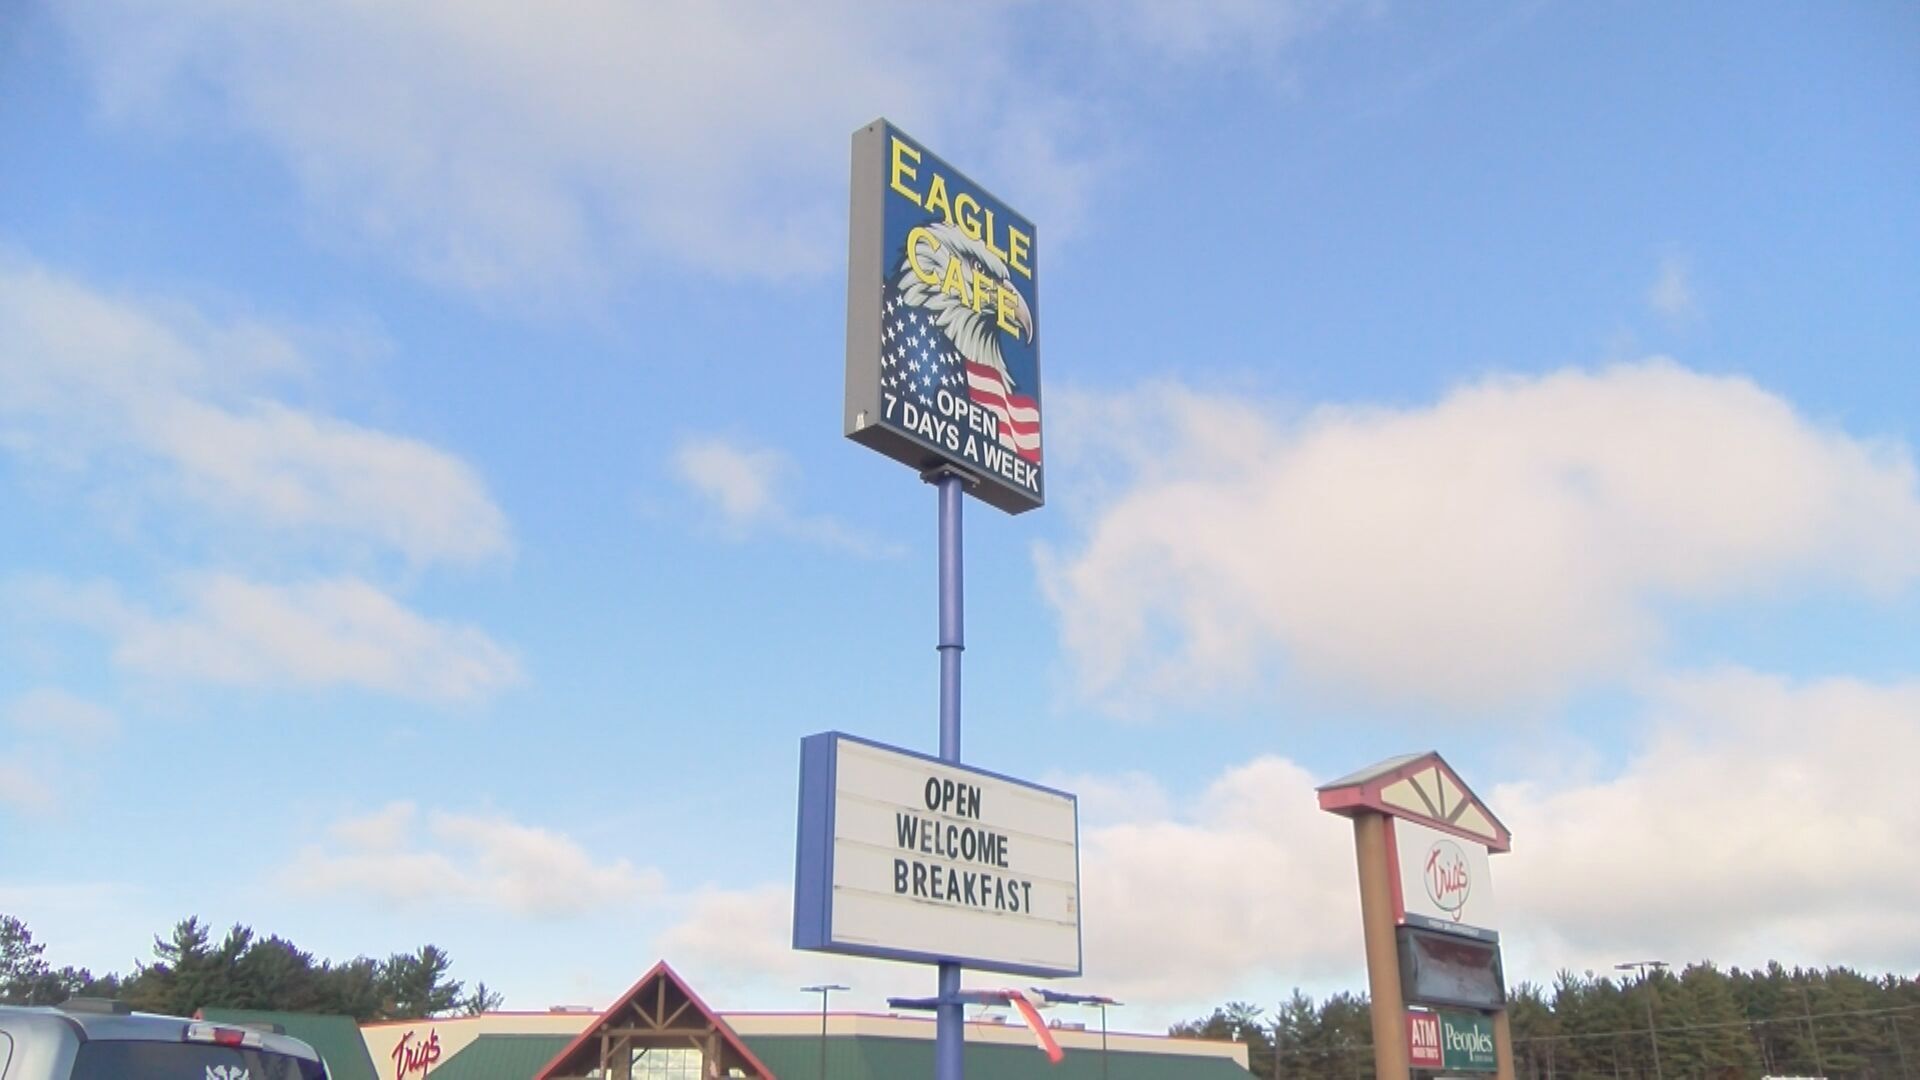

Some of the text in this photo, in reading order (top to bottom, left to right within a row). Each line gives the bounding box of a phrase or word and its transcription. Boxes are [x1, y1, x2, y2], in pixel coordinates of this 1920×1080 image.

[890, 135, 1032, 280] EAGLE
[906, 226, 1020, 340] CAFE
[884, 392, 1039, 493] 7 DAYS A WEEK
[936, 389, 997, 441] OPEN
[924, 776, 981, 820] OPEN
[896, 812, 1009, 868] WELCOME
[894, 858, 1032, 914] BREAKFAST
[1412, 1018, 1438, 1047] ATM
[1444, 1022, 1493, 1062] Peoples
